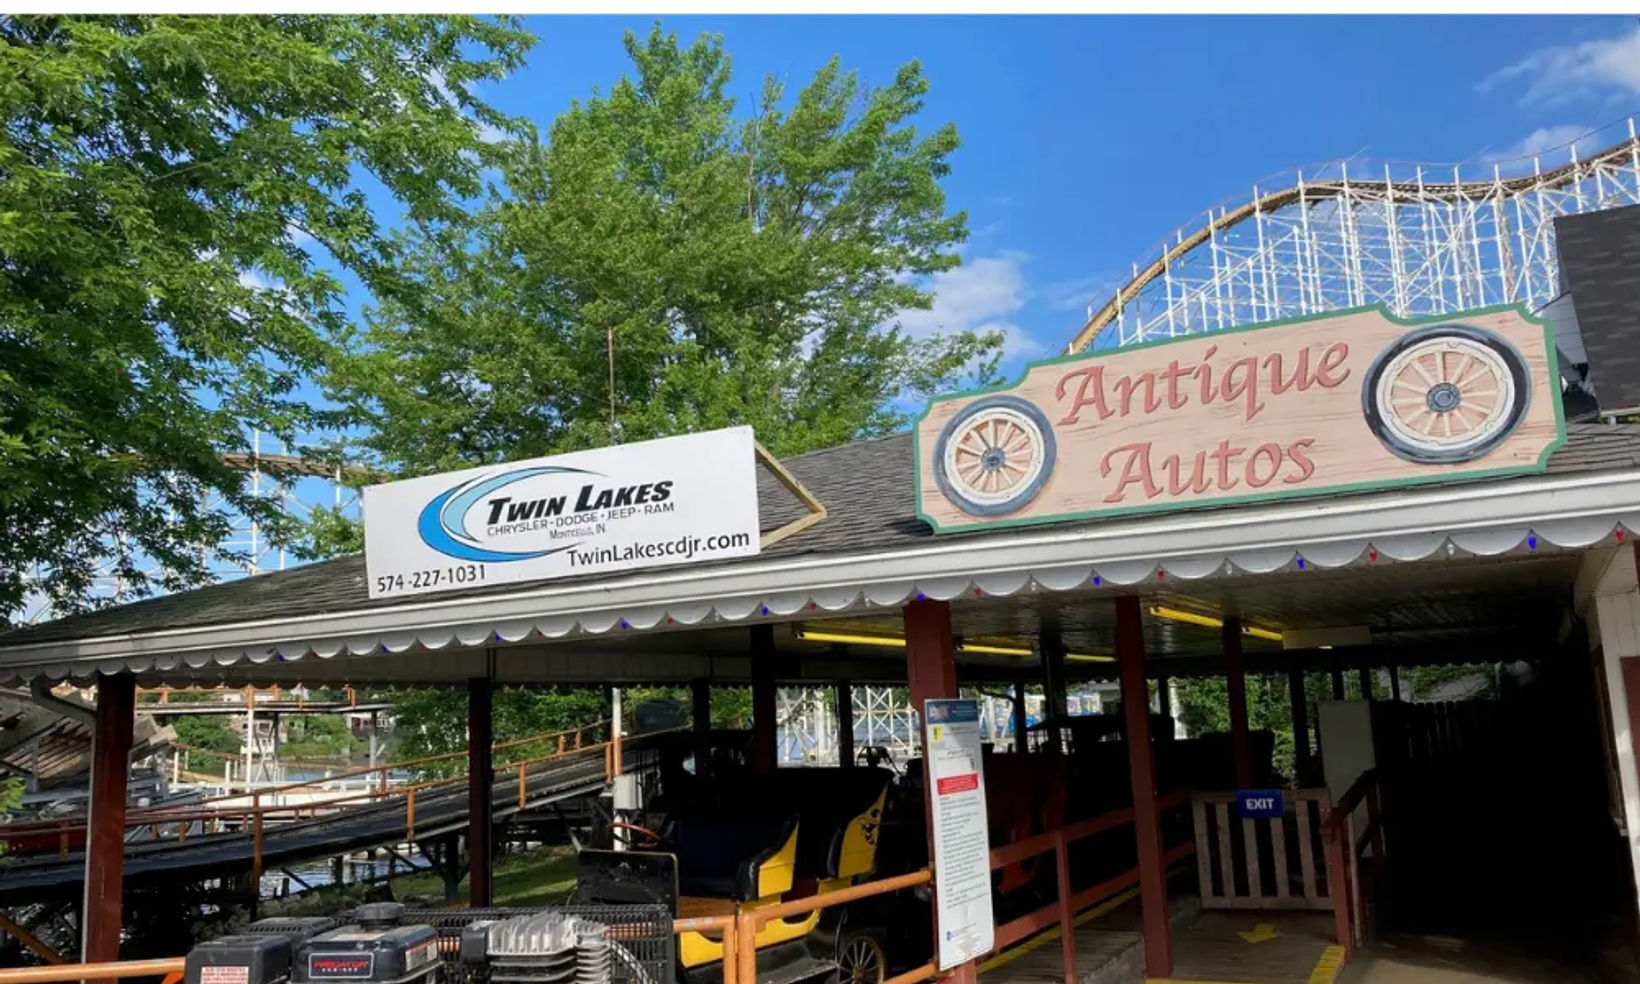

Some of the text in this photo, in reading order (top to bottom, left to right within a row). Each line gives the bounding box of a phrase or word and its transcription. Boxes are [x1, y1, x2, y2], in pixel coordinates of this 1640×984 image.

[1055, 340, 1352, 426] Antique
[1100, 436, 1316, 503] Autos
[487, 480, 674, 526] TWIN LAKES
[487, 502, 675, 537] CHRYSLER DODGE JEEP RAM
[567, 531, 750, 567] TwinLakescdjr.com
[377, 564, 486, 593] 574-227-1031
[1246, 798, 1274, 810] EXIT
